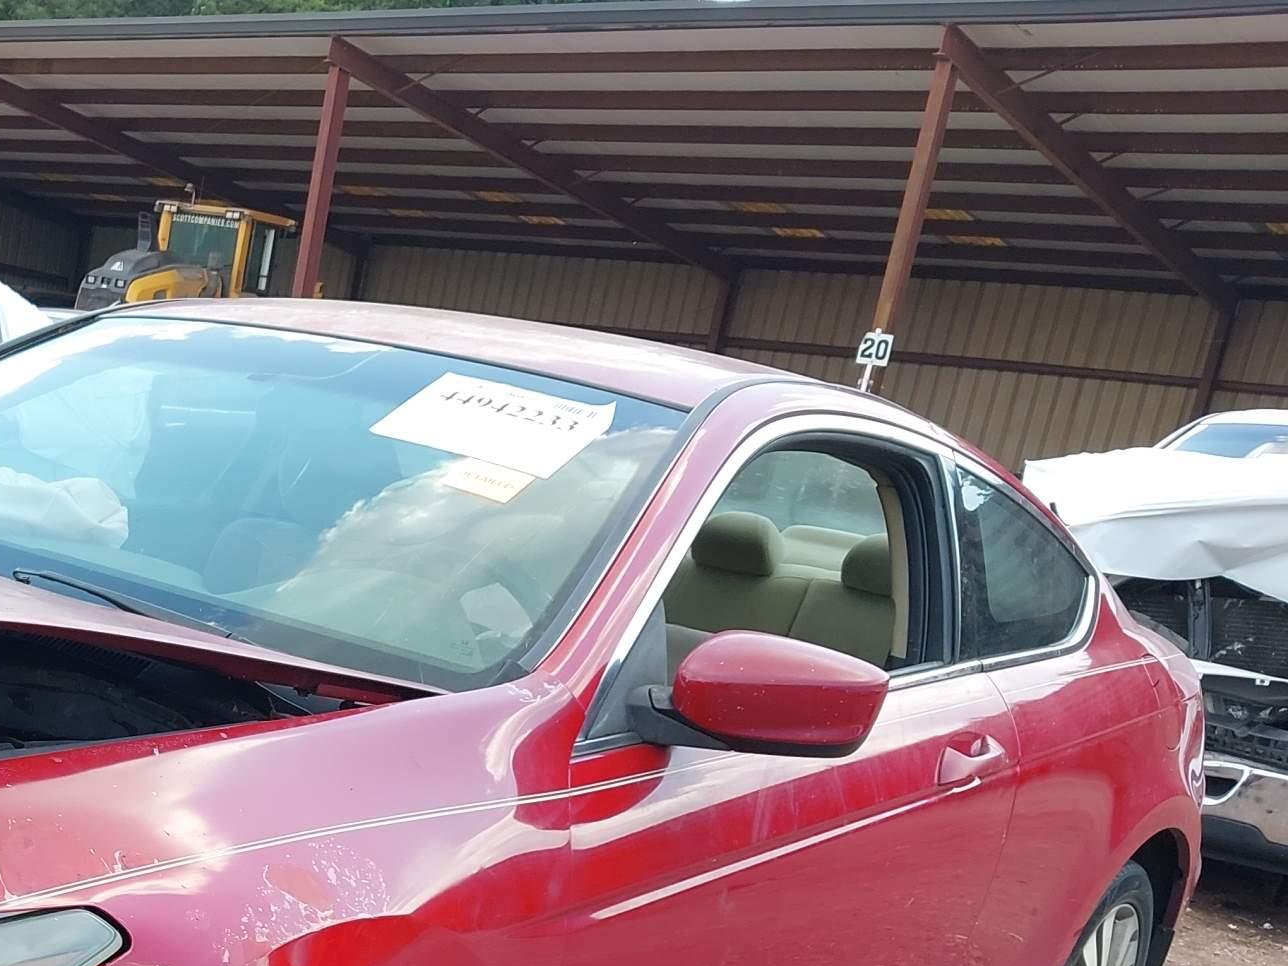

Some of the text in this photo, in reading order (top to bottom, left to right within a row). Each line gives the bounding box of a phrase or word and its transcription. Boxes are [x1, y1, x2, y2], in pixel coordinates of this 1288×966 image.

[172, 213, 240, 229] SCOTTCOMPANIES.COM
[860, 338, 890, 361] 20
[439, 391, 580, 432] 44942233
